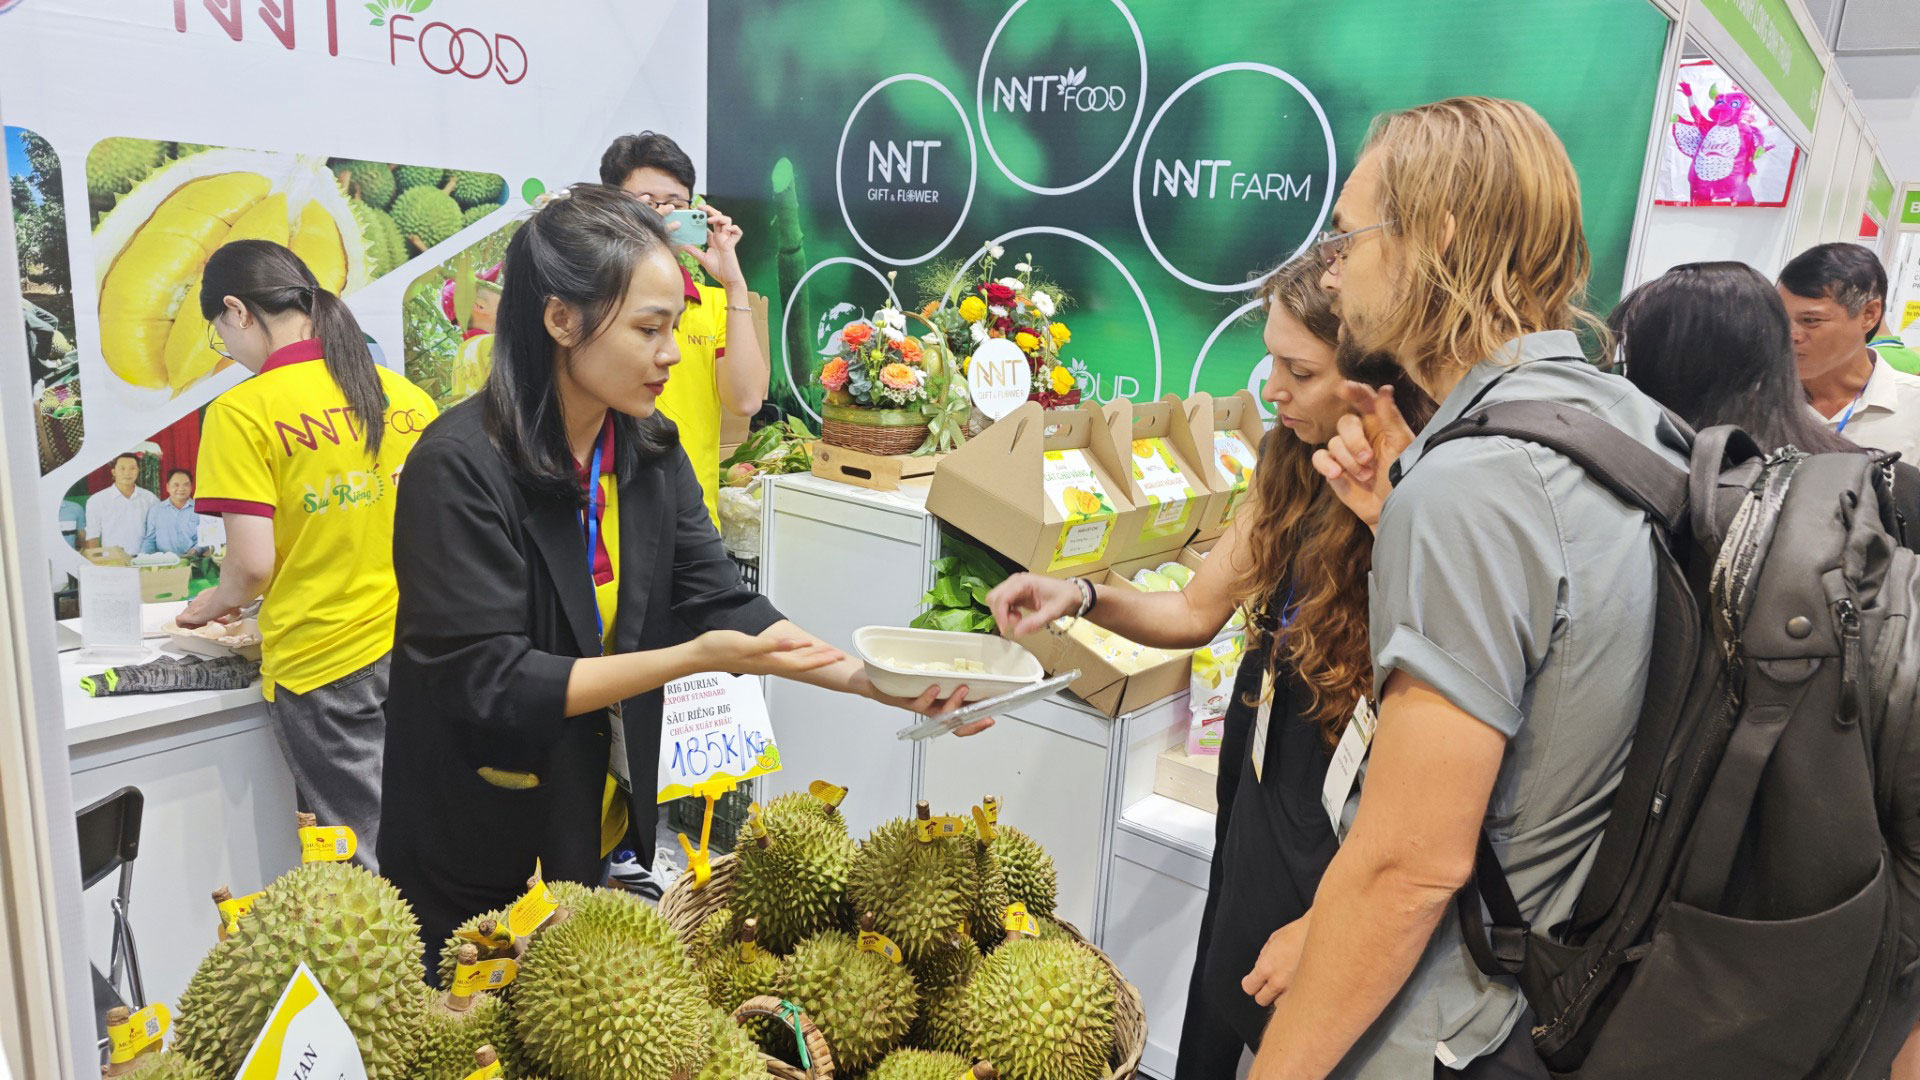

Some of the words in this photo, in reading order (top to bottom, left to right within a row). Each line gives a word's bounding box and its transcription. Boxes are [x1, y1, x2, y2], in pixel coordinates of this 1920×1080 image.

[389, 14, 528, 85] FOOD
[993, 75, 1060, 113] NNT
[1063, 85, 1126, 112] FOOD
[868, 140, 942, 184] NNT
[867, 188, 889, 201] GIFT
[897, 189, 939, 203] FLOWER
[1152, 158, 1232, 199] NNT
[1230, 172, 1312, 202] FARM
[978, 391, 993, 400] GIFT
[997, 389, 1025, 399] FLOWER
[1076, 370, 1140, 404] OUP
[663, 693, 689, 705] EXPORT
[691, 688, 726, 701] STANDARD
[667, 684, 682, 694] RI6
[683, 677, 719, 691] DURIAN
[687, 704, 715, 720] RIÊNG
[717, 703, 731, 714] RI6
[292, 1043, 318, 1080] IAN
